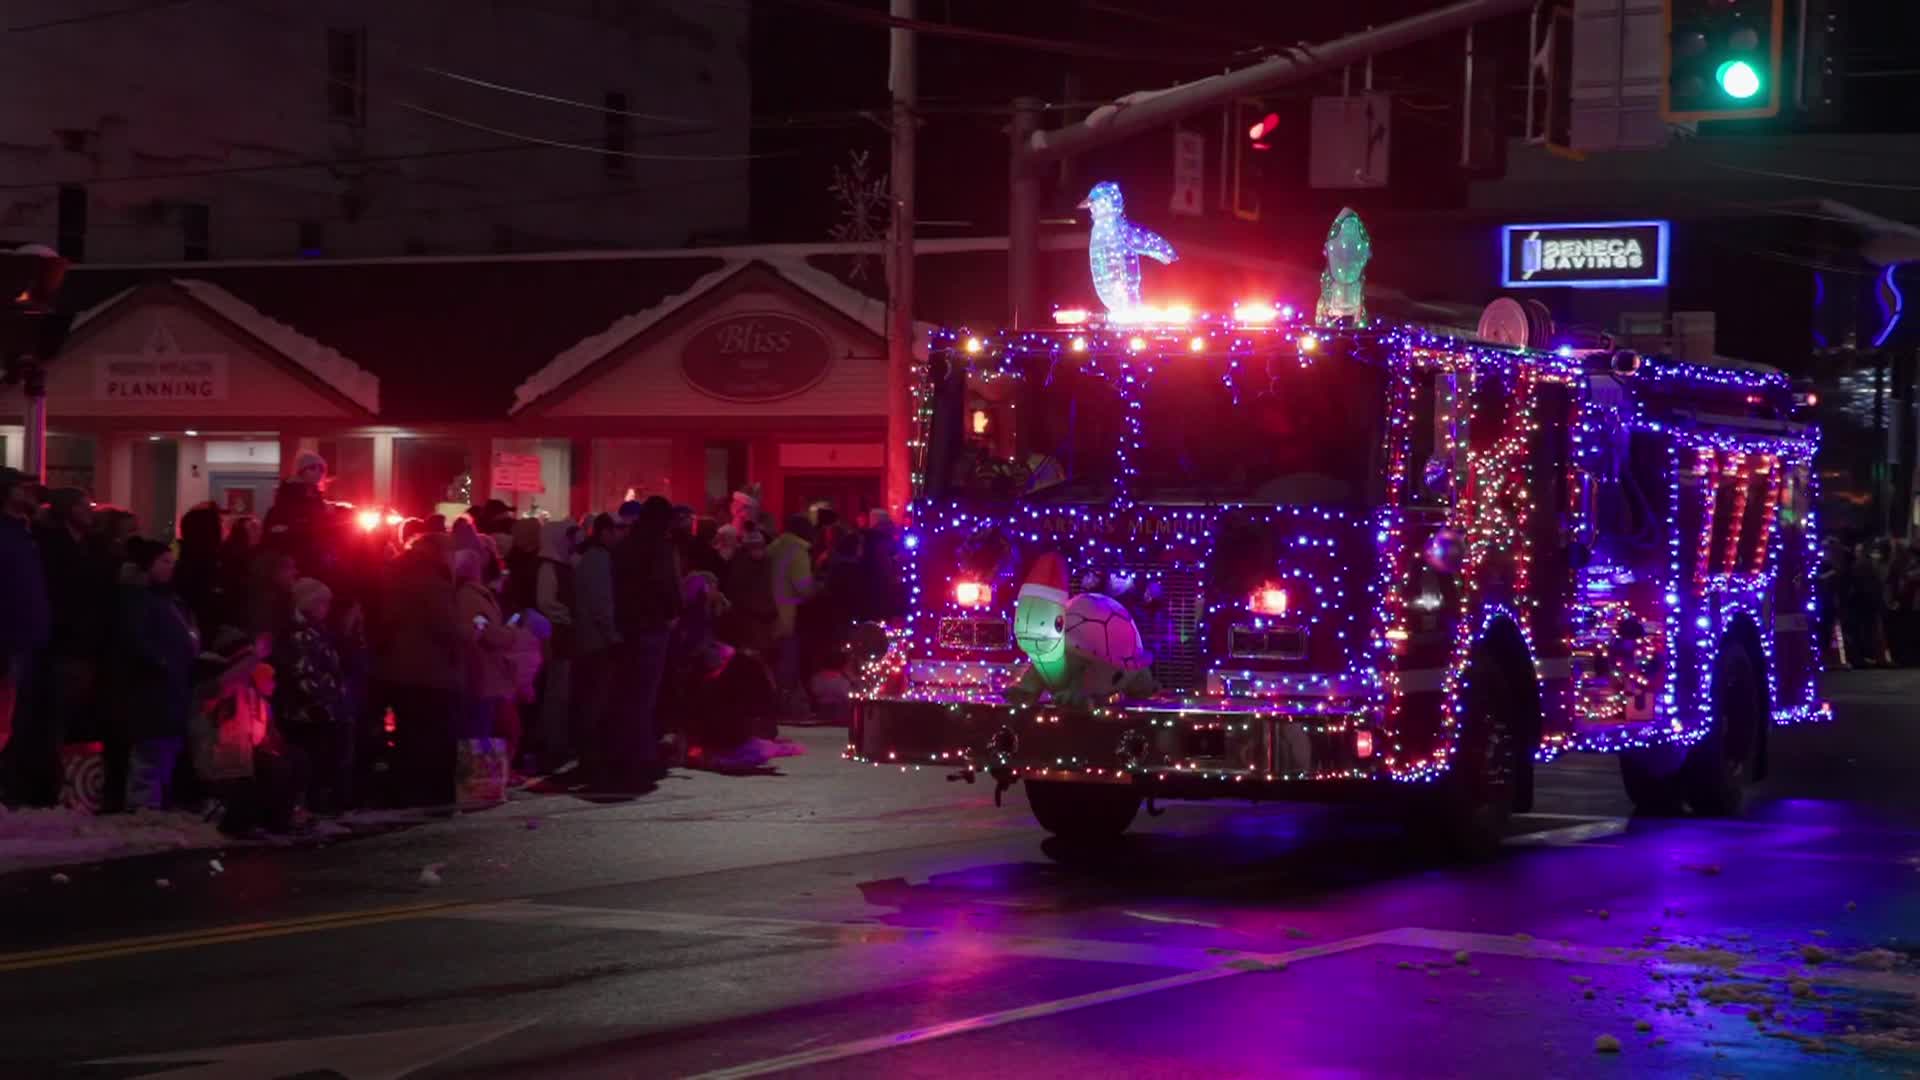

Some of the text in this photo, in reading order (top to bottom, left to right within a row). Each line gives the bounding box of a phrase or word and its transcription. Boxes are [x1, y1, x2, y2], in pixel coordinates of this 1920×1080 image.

[1542, 239, 1642, 257] SENECA
[1542, 255, 1643, 270] SAVINGS
[715, 320, 793, 353] Bliss
[107, 381, 213, 397] PLANNING
